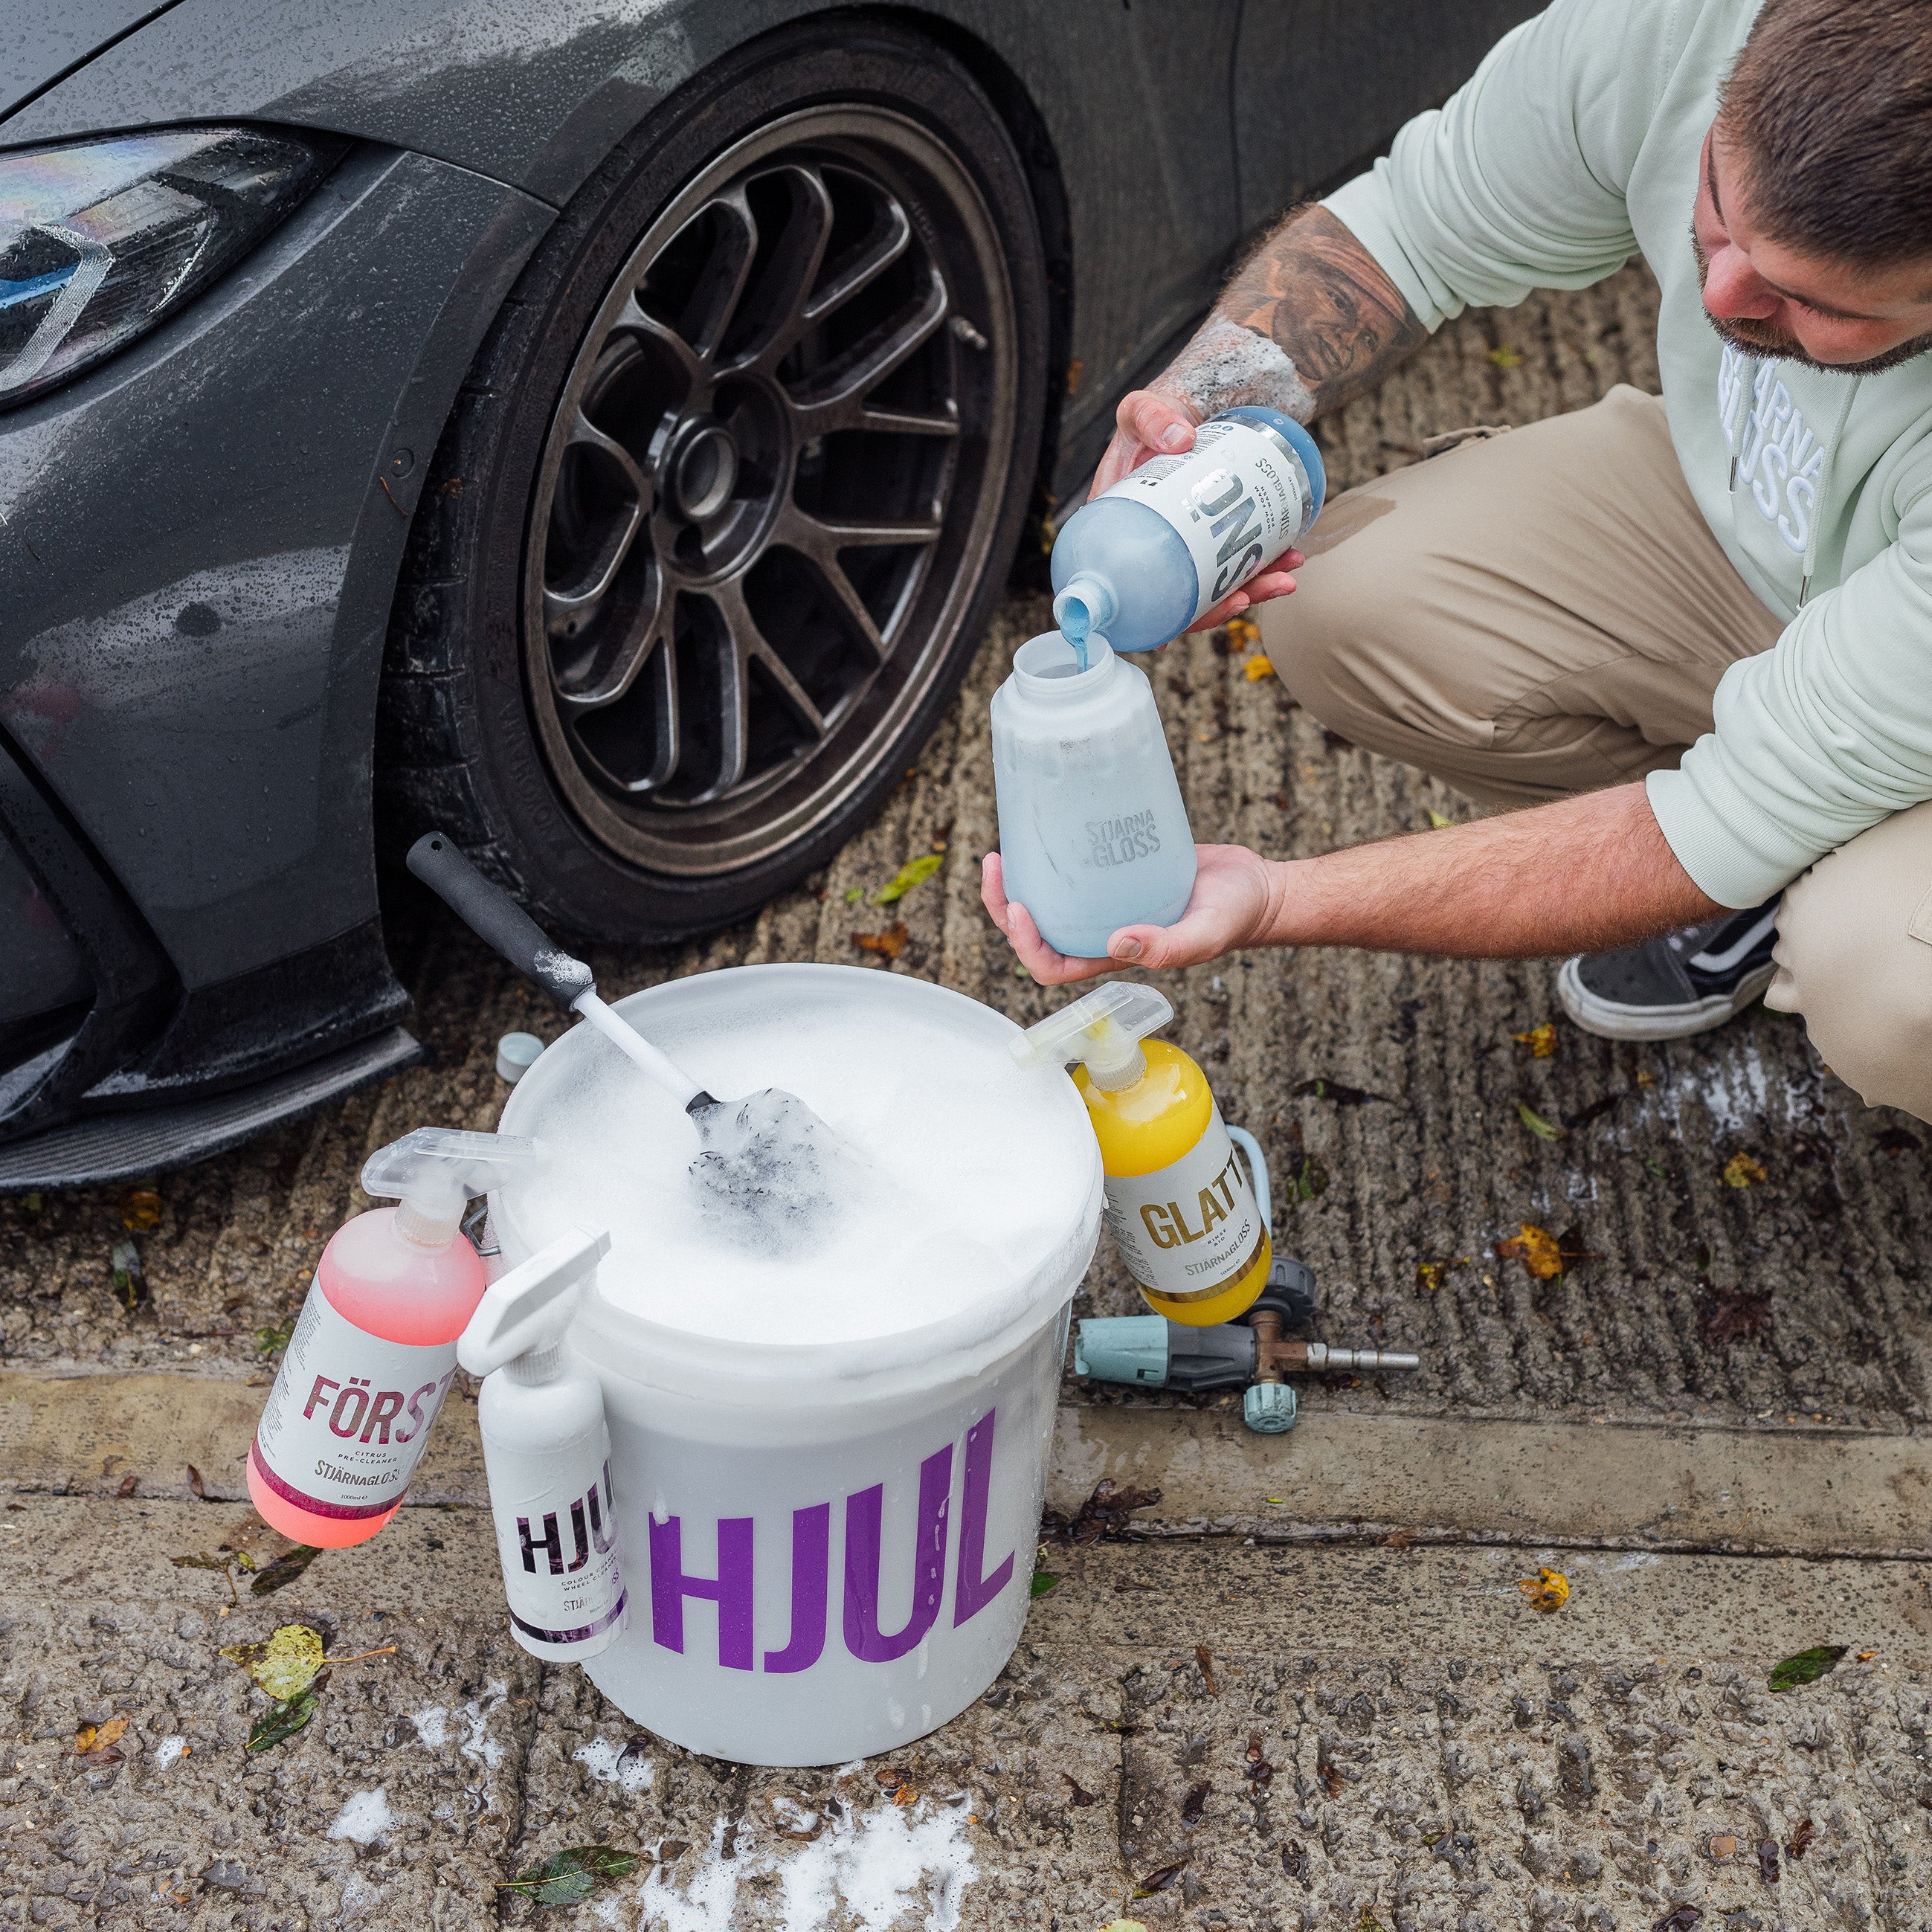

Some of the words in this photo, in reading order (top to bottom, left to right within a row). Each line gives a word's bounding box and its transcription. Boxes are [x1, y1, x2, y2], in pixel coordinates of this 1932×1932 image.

[1255, 458, 1290, 541] STJÄRNAGLOSS
[1260, 486, 1275, 528] PRE-WASH
[1181, 468, 1263, 603] SNÖ
[1092, 823, 1161, 869] GLOSS
[1139, 1148, 1243, 1249] GLATT
[1185, 1218, 1251, 1276] STJÄRNAGLOSS
[1207, 1228, 1228, 1245] RINSE
[1214, 1236, 1226, 1247] AID
[303, 1364, 459, 1445] FÖRST
[338, 1453, 398, 1464] PRE-CLEANER
[516, 1458, 619, 1576] HJU
[648, 1407, 1016, 1674] HJUL
[561, 1572, 593, 1586] COLOUR
[563, 1580, 590, 1591] WHEEL
